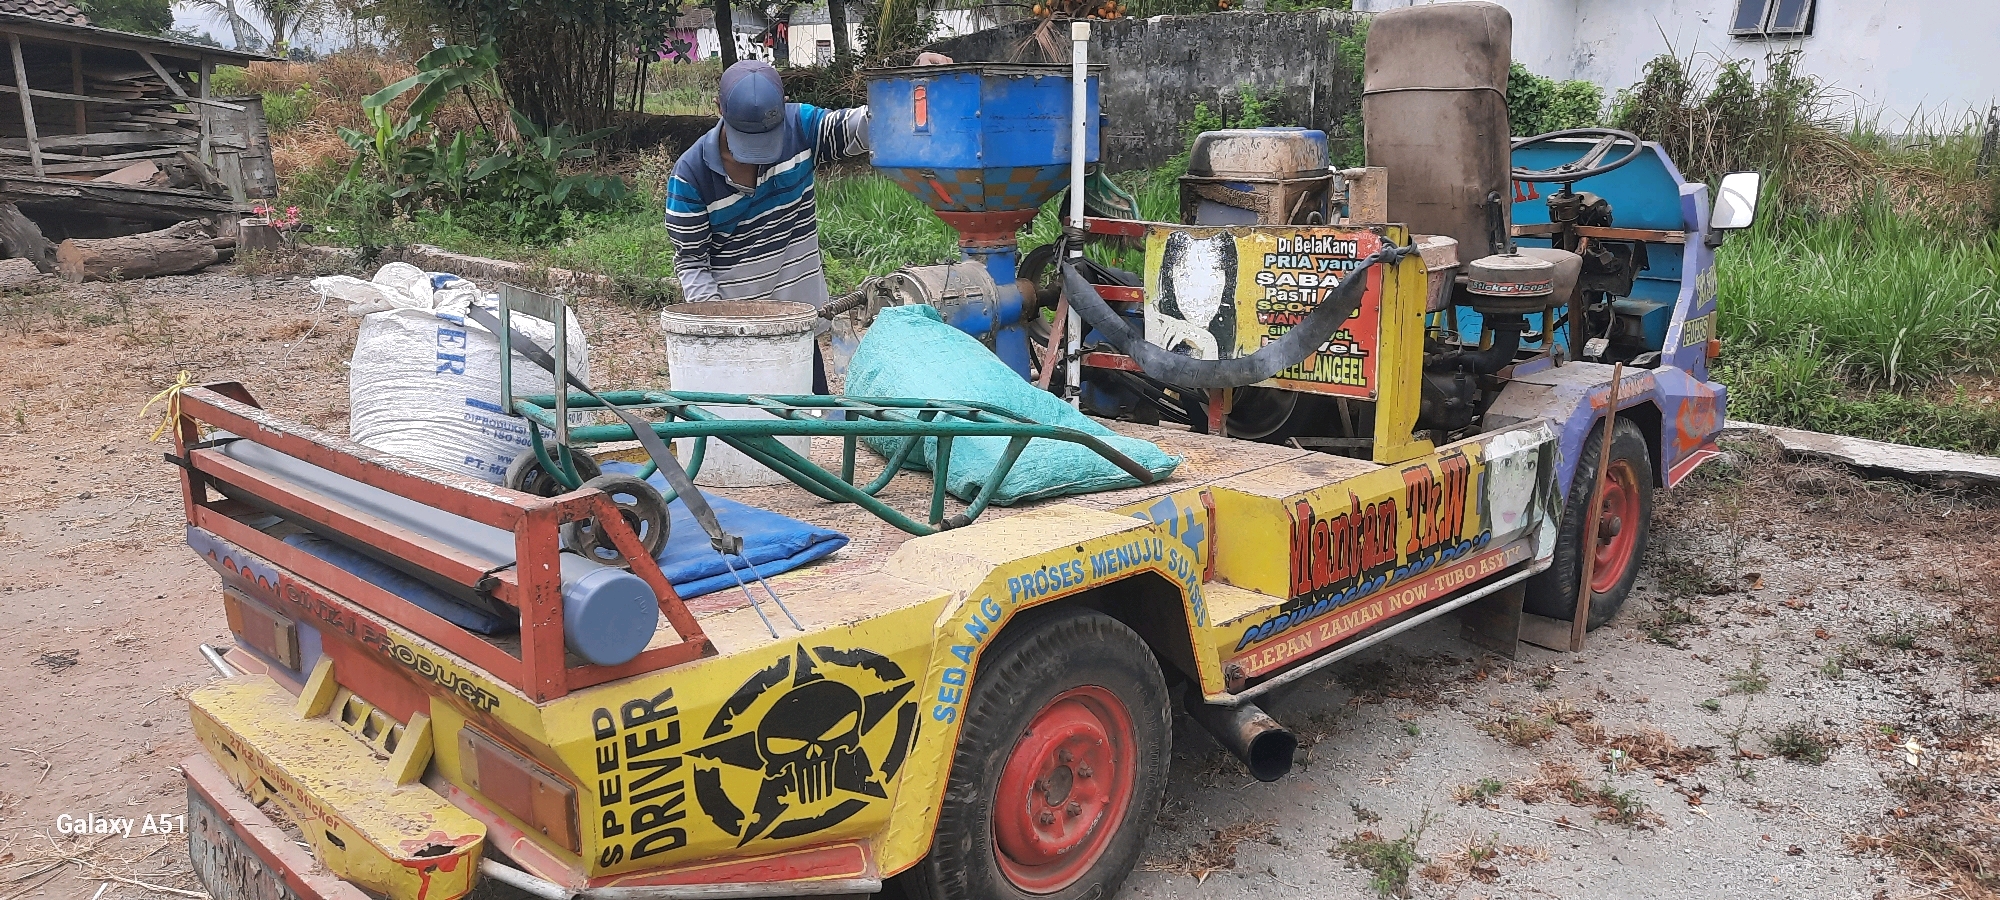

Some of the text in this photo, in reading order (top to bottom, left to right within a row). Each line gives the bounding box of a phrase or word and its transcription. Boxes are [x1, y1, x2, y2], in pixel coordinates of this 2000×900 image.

[1264, 254, 1312, 269] PRIA
[1294, 235, 1357, 258] BelaKang
[1256, 271, 1341, 288] SABA
[1265, 286, 1317, 303] PasTi
[435, 312, 467, 376] ER
[489, 463, 507, 476] MA
[932, 537, 1208, 724] SEDANG PROSES MENUJU SUKSES
[1320, 601, 1384, 642] ZAMAN
[361, 623, 500, 713] PRODUCT
[591, 706, 625, 868] SPEED
[619, 687, 687, 860] DRIVER
[296, 787, 340, 831] Sticker
